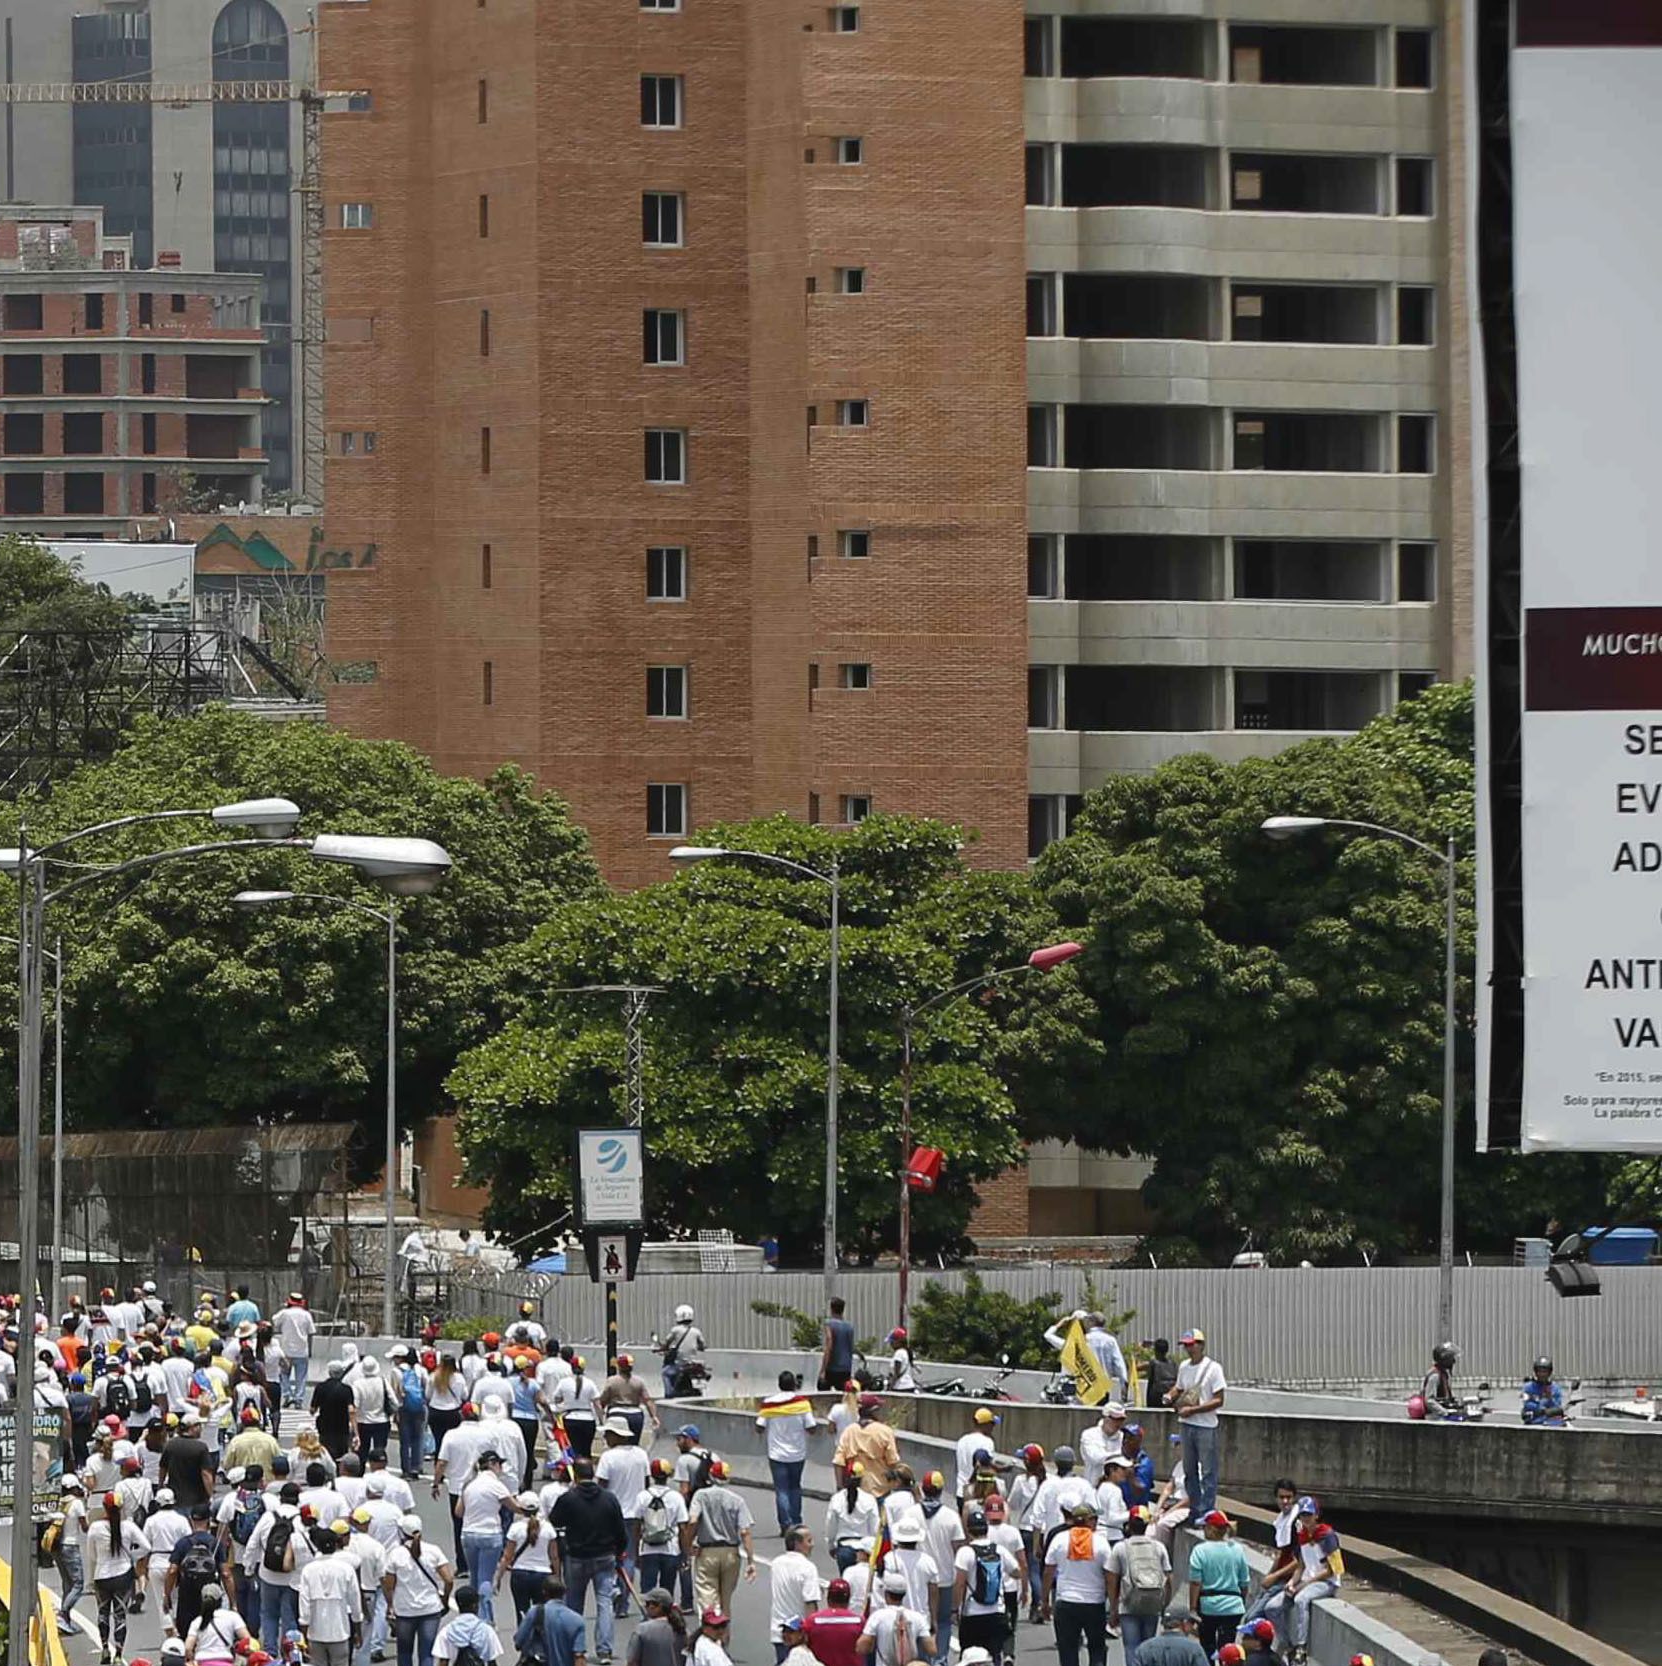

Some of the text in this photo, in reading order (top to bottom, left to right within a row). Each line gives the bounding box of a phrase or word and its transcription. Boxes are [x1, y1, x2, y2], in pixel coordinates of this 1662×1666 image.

[1581, 632, 1662, 657] MUCH
[1624, 724, 1662, 756] SE
[1616, 783, 1662, 814] EV
[1612, 841, 1662, 873] AD
[1613, 1017, 1661, 1048] VA
[1563, 1094, 1589, 1106] Solo
[1591, 1097, 1616, 1107] para
[1594, 1108, 1607, 1118] La
[1610, 1108, 1650, 1120] palabra
